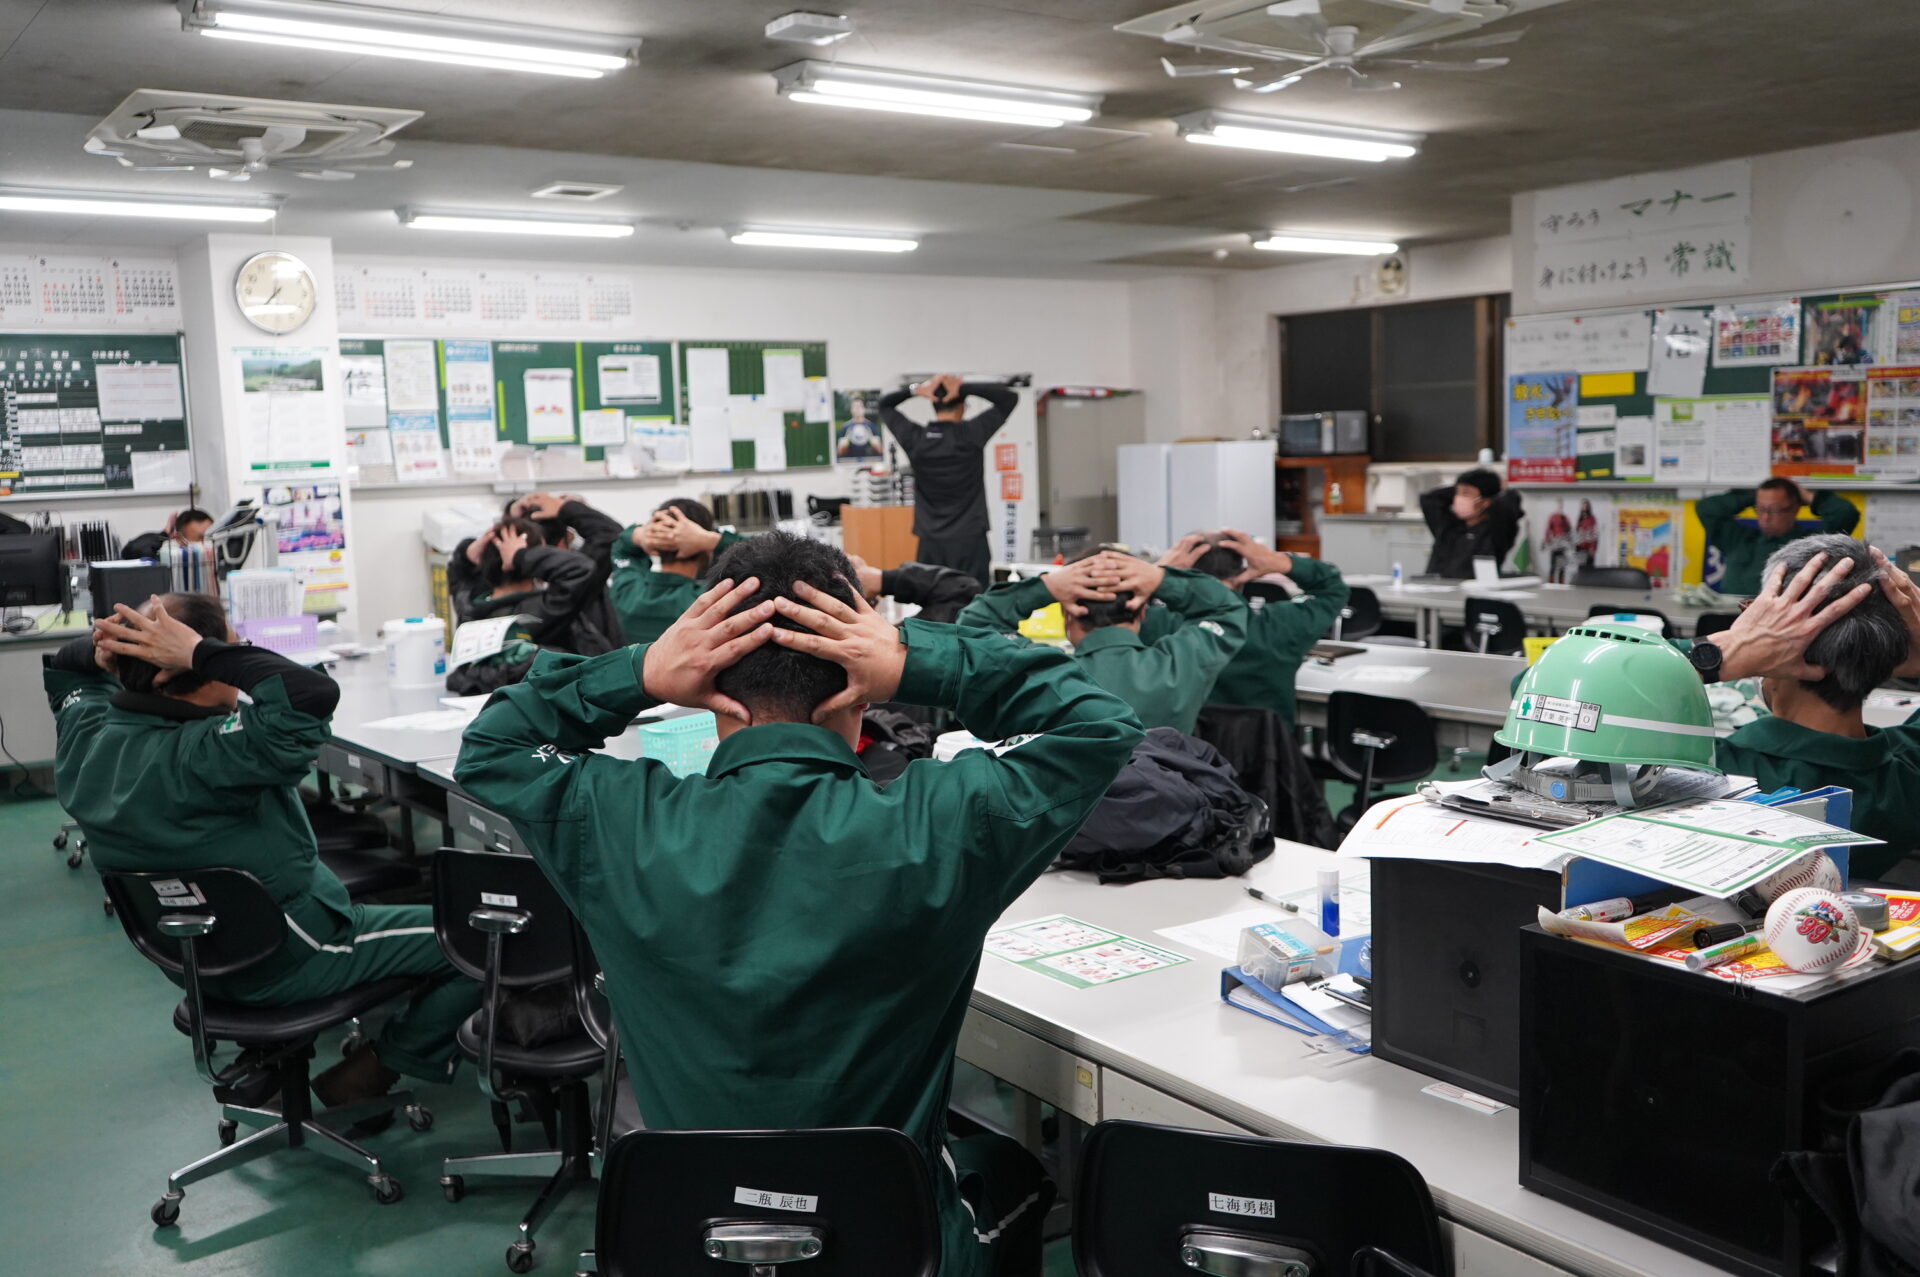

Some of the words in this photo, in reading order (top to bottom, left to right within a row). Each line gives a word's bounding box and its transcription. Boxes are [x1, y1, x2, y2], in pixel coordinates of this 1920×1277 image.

[1540, 207, 1601, 233] 守ろう
[1619, 189, 1736, 216] マナー
[1539, 256, 1648, 288] 身に付けよう
[1665, 239, 1737, 277] 常識
[1797, 917, 1830, 943] 99
[745, 1192, 772, 1206] 二瓶
[779, 1195, 807, 1210] 辰也
[1210, 1195, 1273, 1216] 七海勇樹
